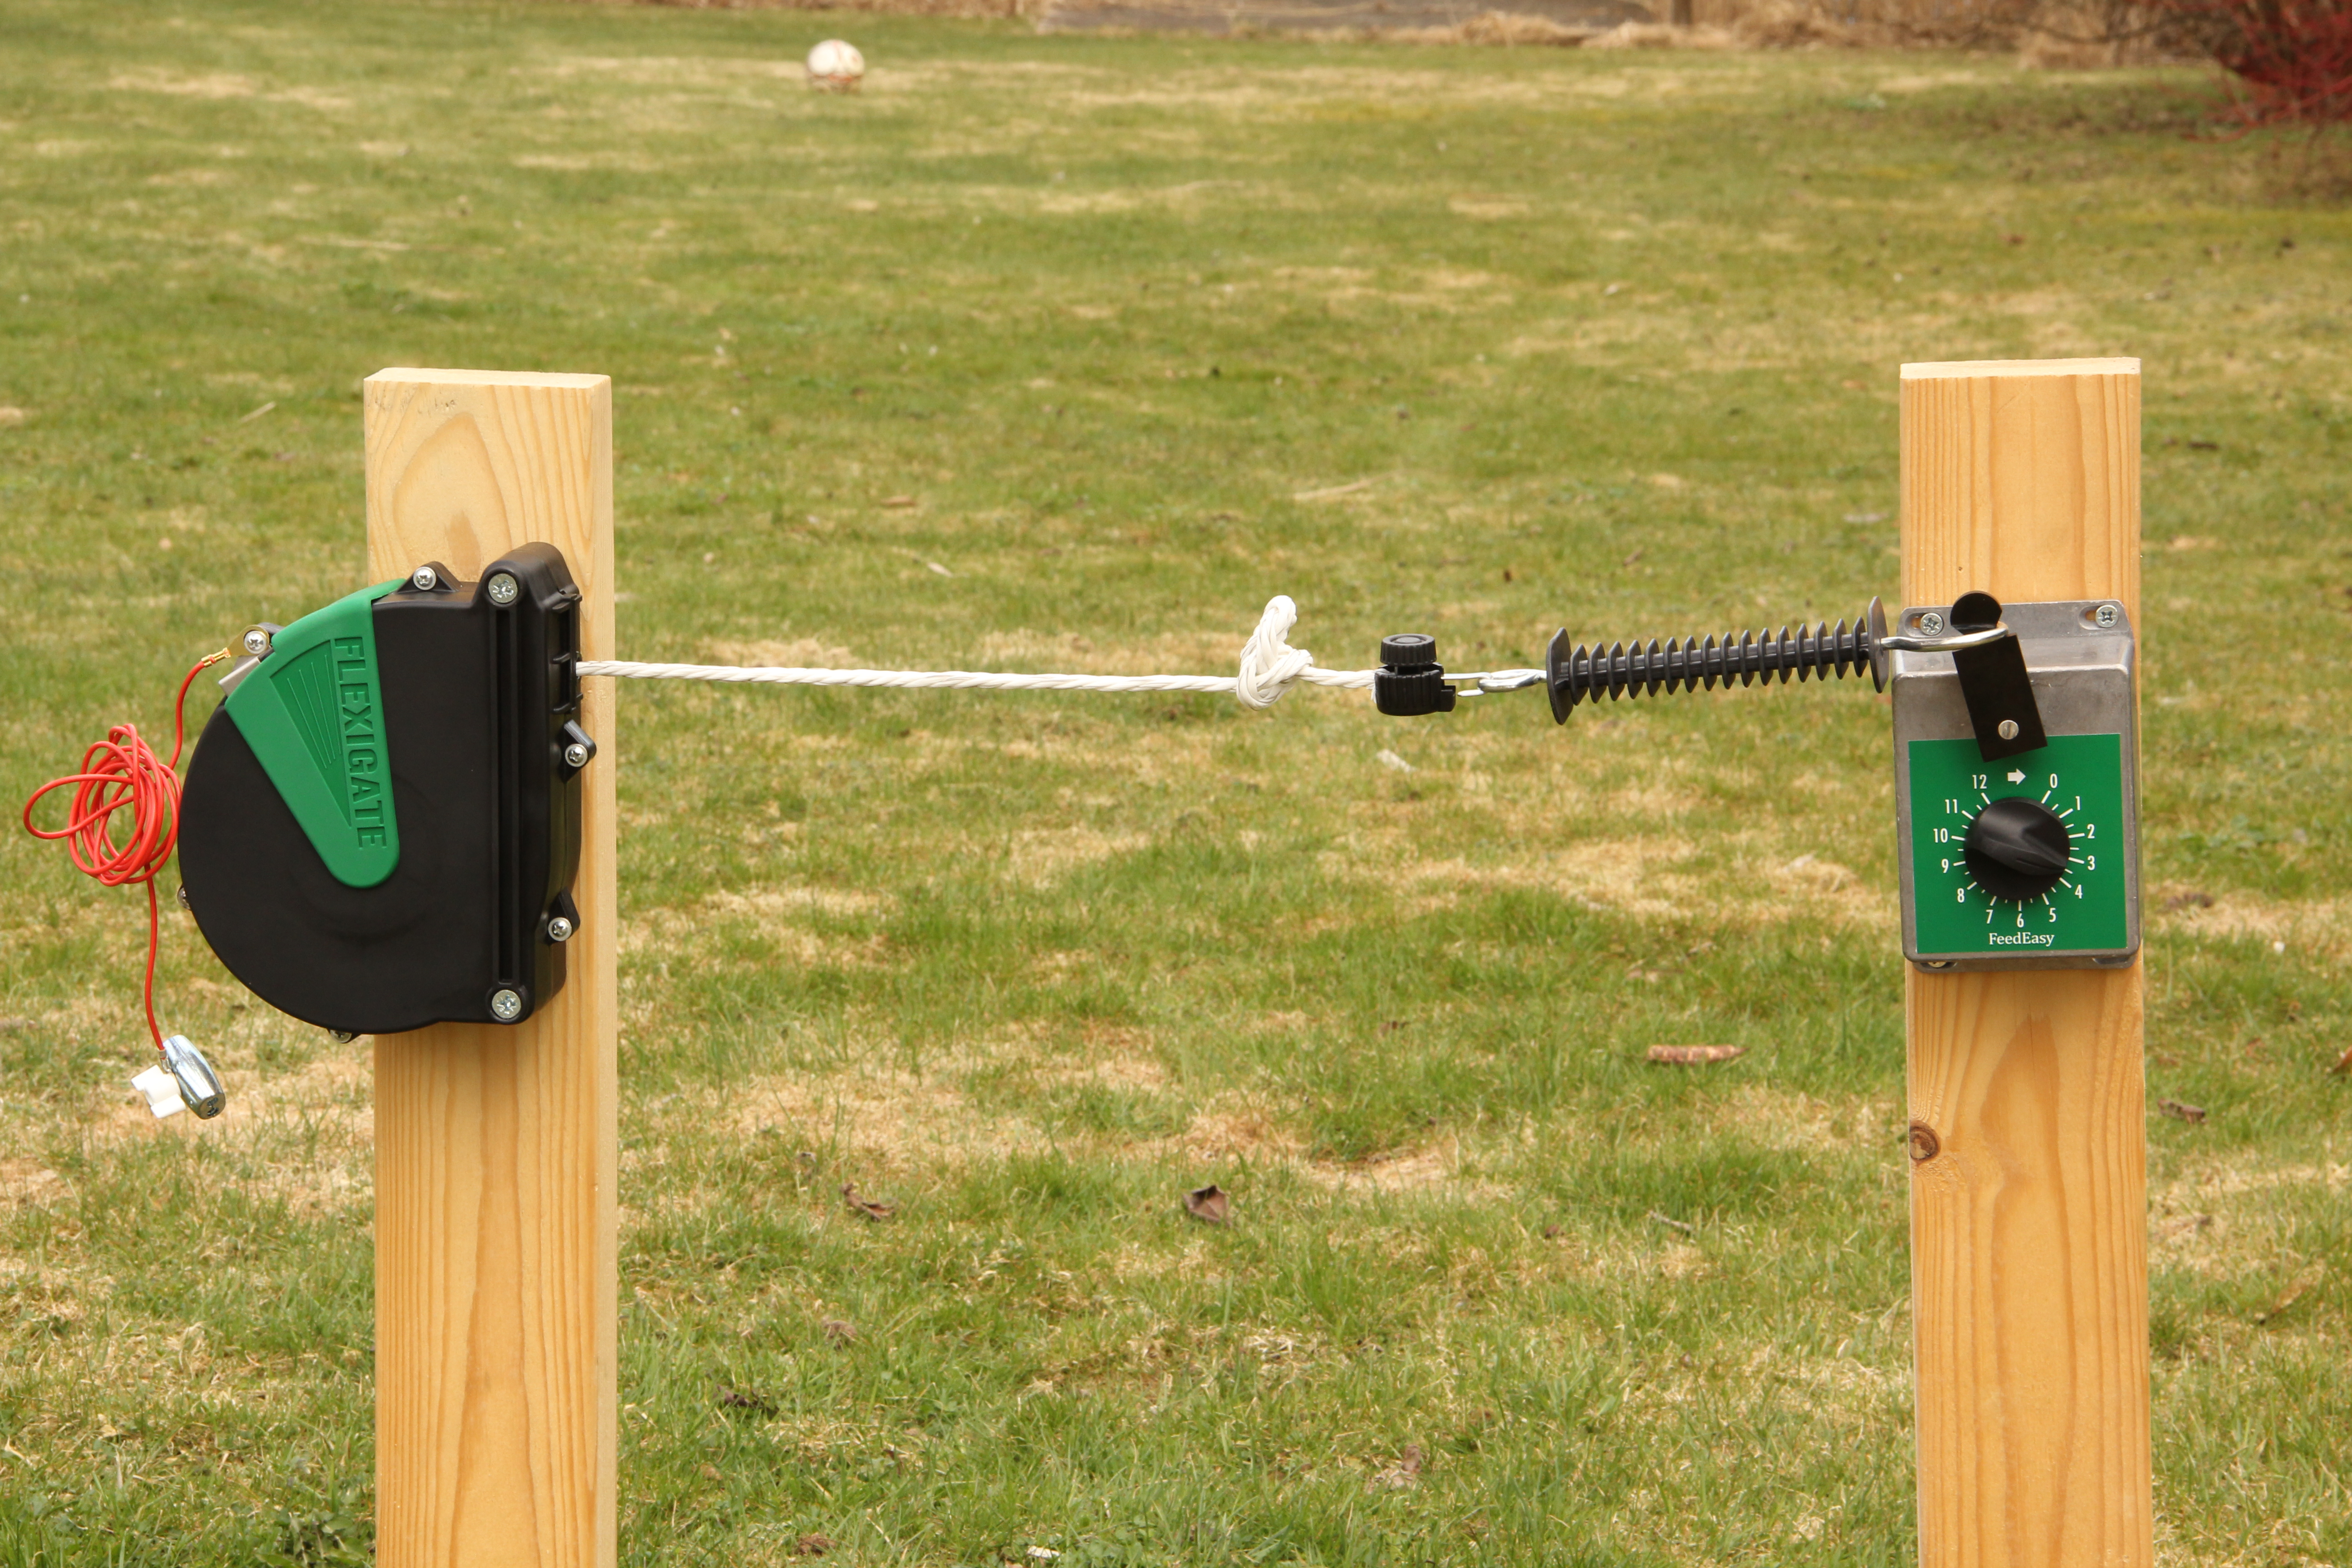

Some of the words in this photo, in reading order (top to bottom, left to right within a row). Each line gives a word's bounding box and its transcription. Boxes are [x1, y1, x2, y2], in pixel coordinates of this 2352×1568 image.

[334, 636, 387, 849] FLEXIGATE
[1972, 774, 1987, 789] 12
[2049, 773, 2058, 789] 0
[1945, 799, 1958, 814] 11
[2075, 795, 2081, 811] 1
[1933, 828, 1948, 843] 10
[2087, 823, 2095, 839] 2
[1941, 858, 1949, 873] 9
[2087, 855, 2095, 871] 3
[1957, 887, 1965, 903] 8
[2074, 884, 2083, 899] 4
[1986, 909, 1993, 924] 7
[2016, 913, 2024, 928] 6
[2048, 907, 2057, 922] 5
[1989, 931, 2055, 947] FeedEasy
